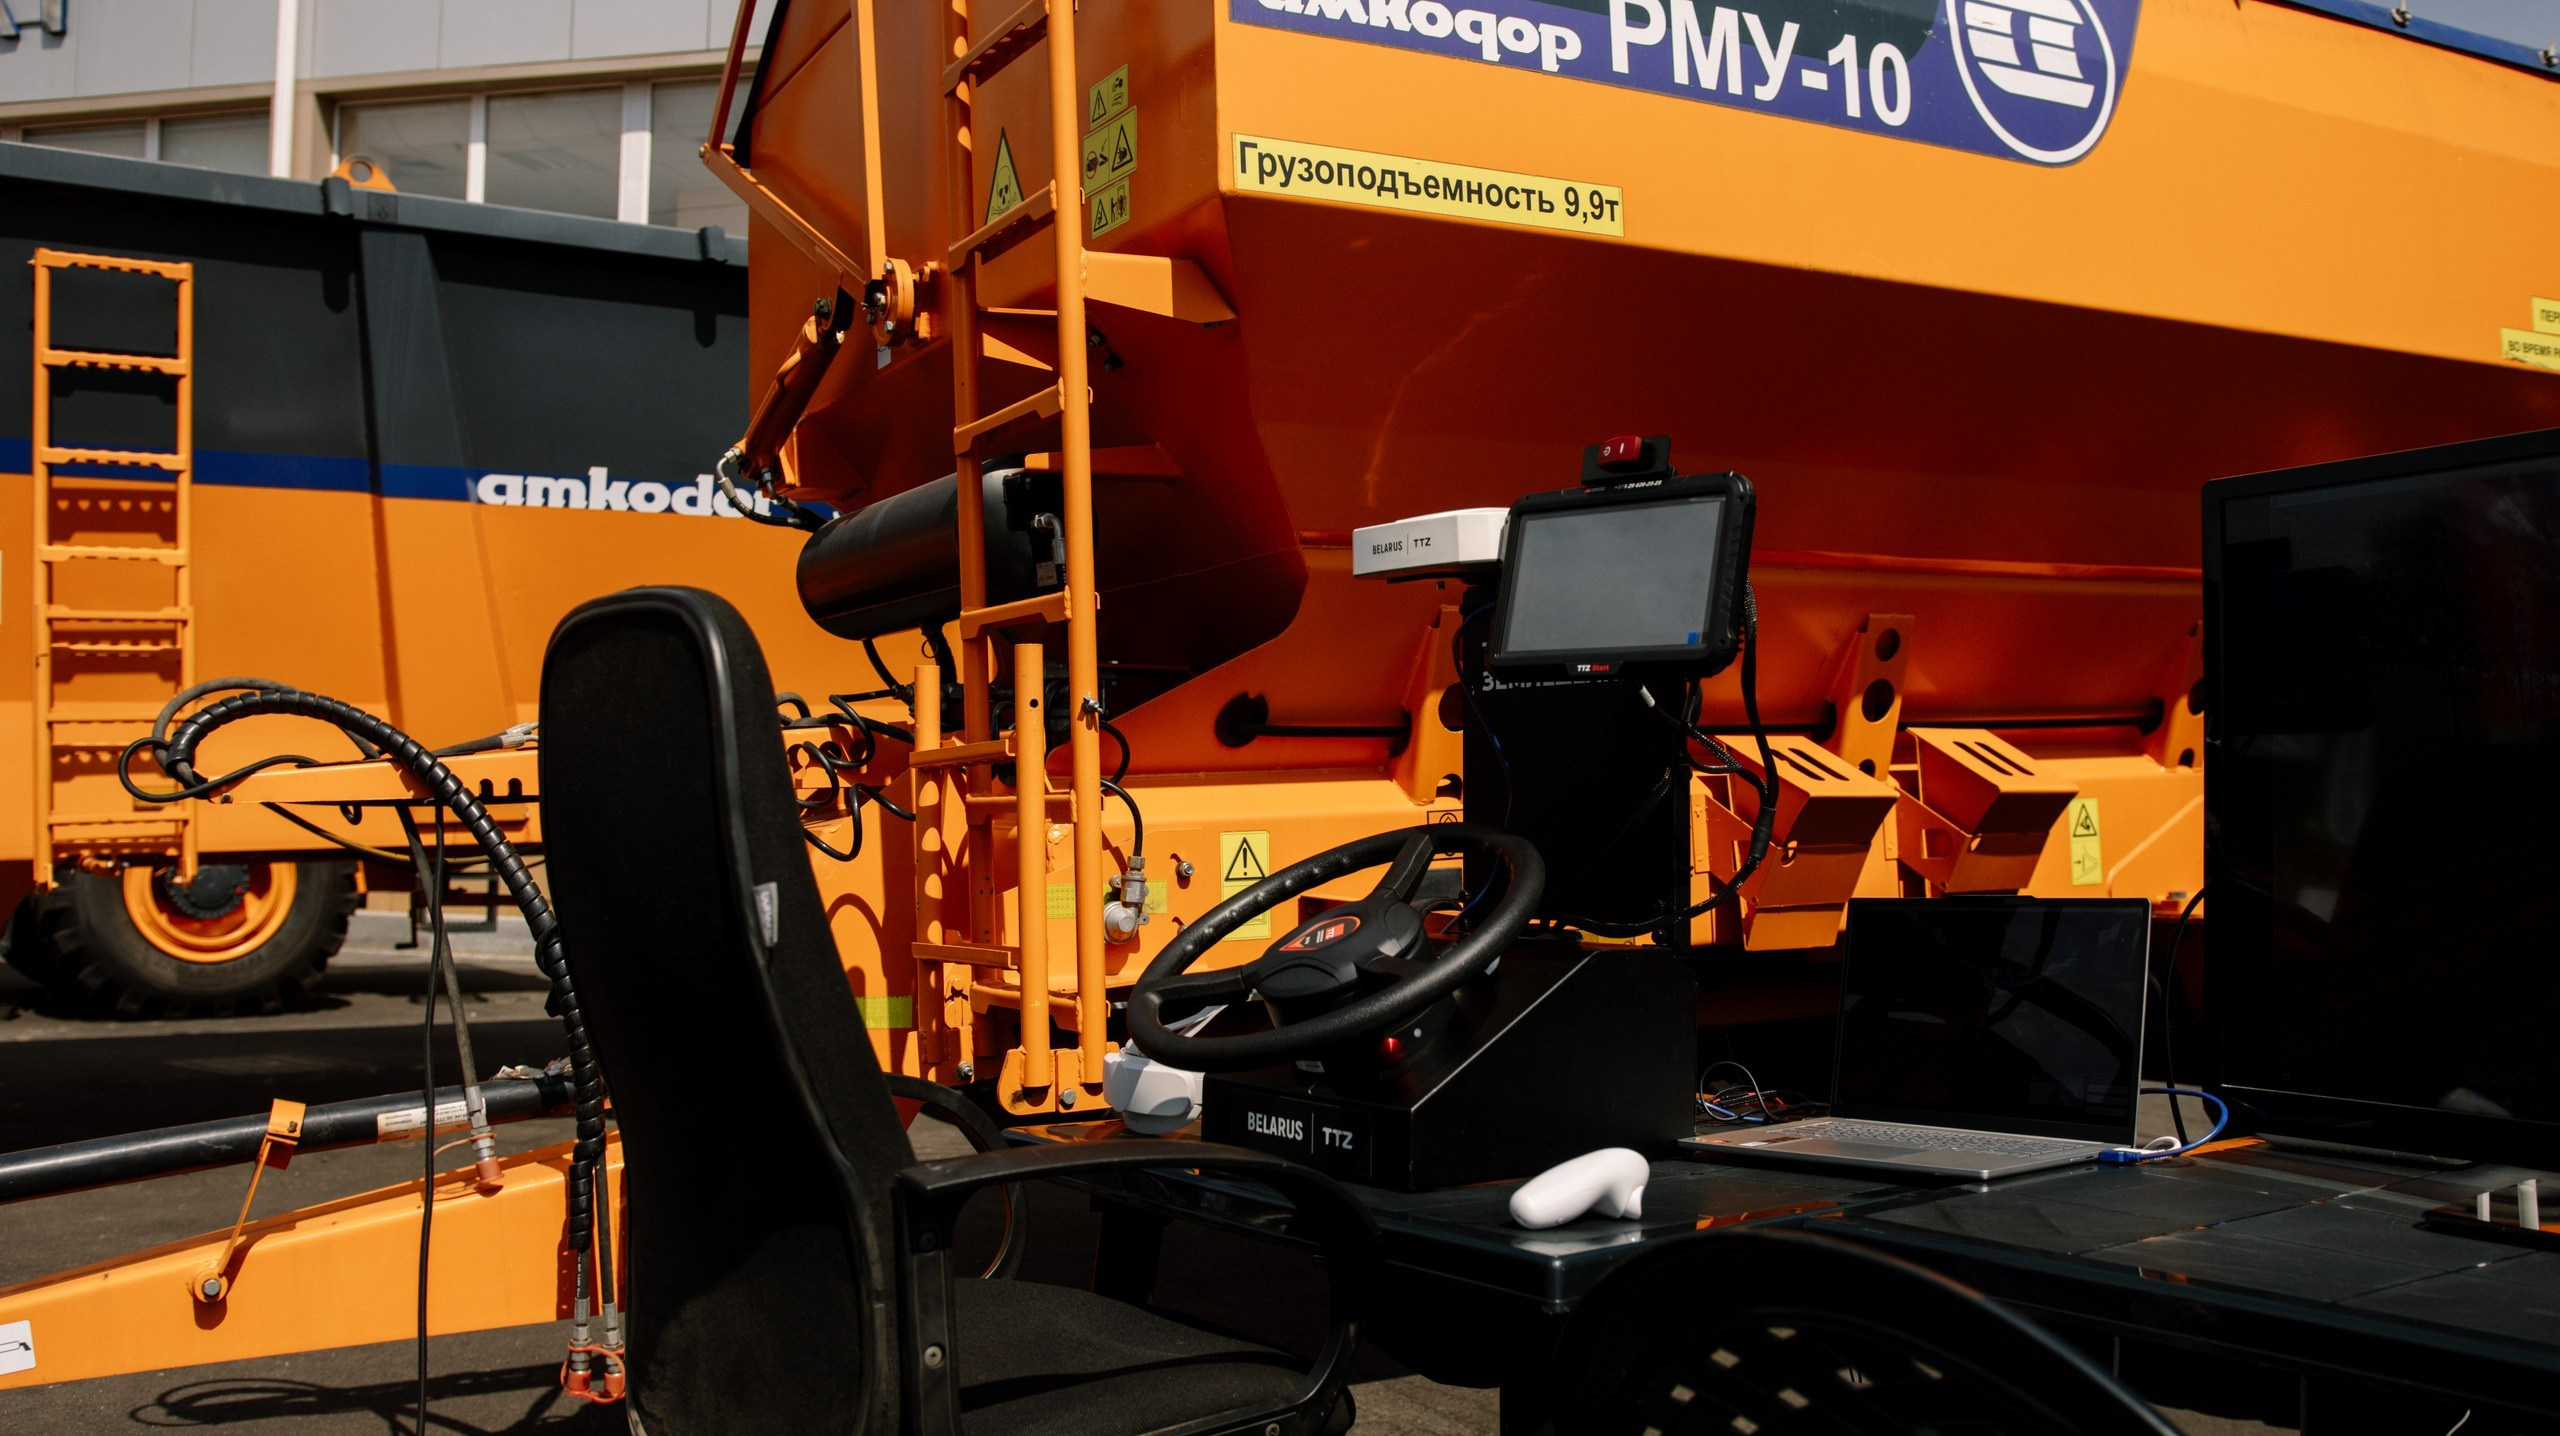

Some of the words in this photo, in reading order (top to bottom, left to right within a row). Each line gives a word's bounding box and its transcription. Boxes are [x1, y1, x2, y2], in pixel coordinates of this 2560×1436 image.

[1609, 0, 1911, 127] РМУ-10
[1239, 140, 1556, 214] Грузоподъемность
[1563, 186, 1620, 223] 9,9т
[1372, 540, 1403, 555] BELARUS
[1413, 537, 1431, 548] TTZ
[1577, 664, 1591, 672] TTZ
[1592, 664, 1611, 672] Start
[1247, 1111, 1304, 1141] BELARUS
[1322, 1126, 1353, 1150] TTZ
